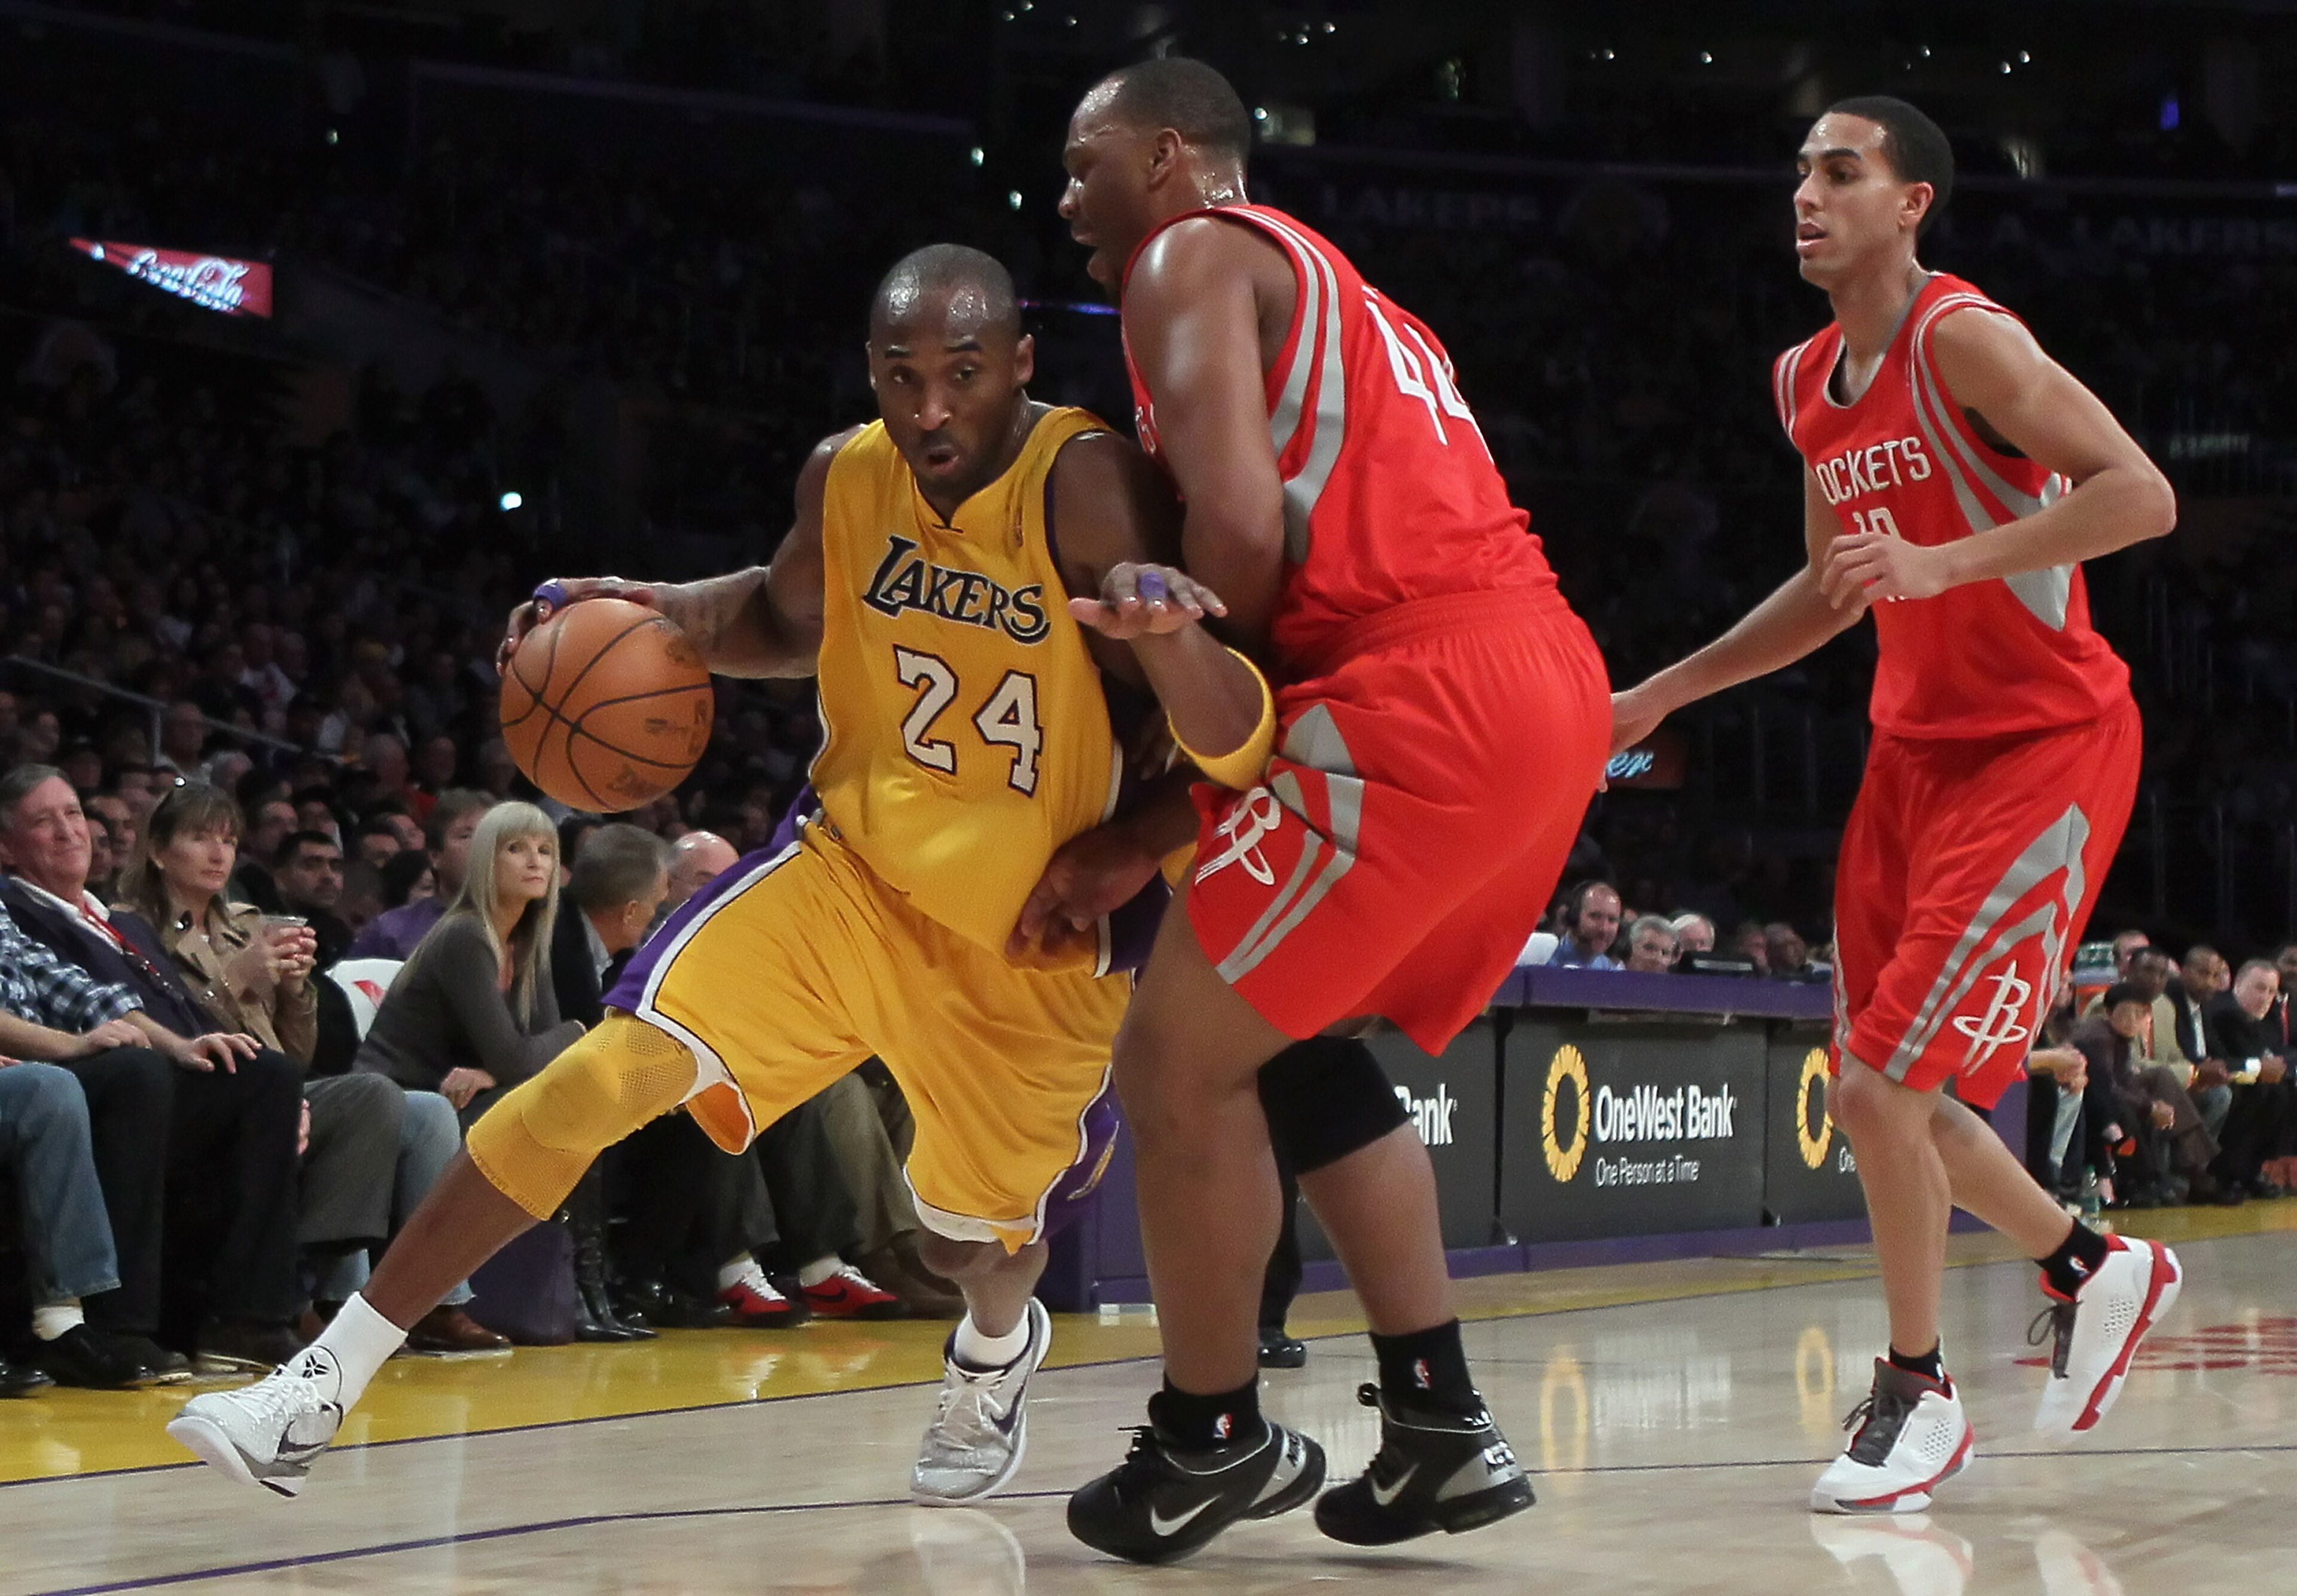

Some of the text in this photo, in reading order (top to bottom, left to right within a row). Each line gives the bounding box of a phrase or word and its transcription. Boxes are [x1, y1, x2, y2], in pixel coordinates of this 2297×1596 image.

[863, 535, 1051, 645] LAKERS
[893, 643, 1044, 797] 24
[1596, 1082, 1734, 1141] OneWest Bank
[1595, 1154, 1700, 1187] One Person at a Time
